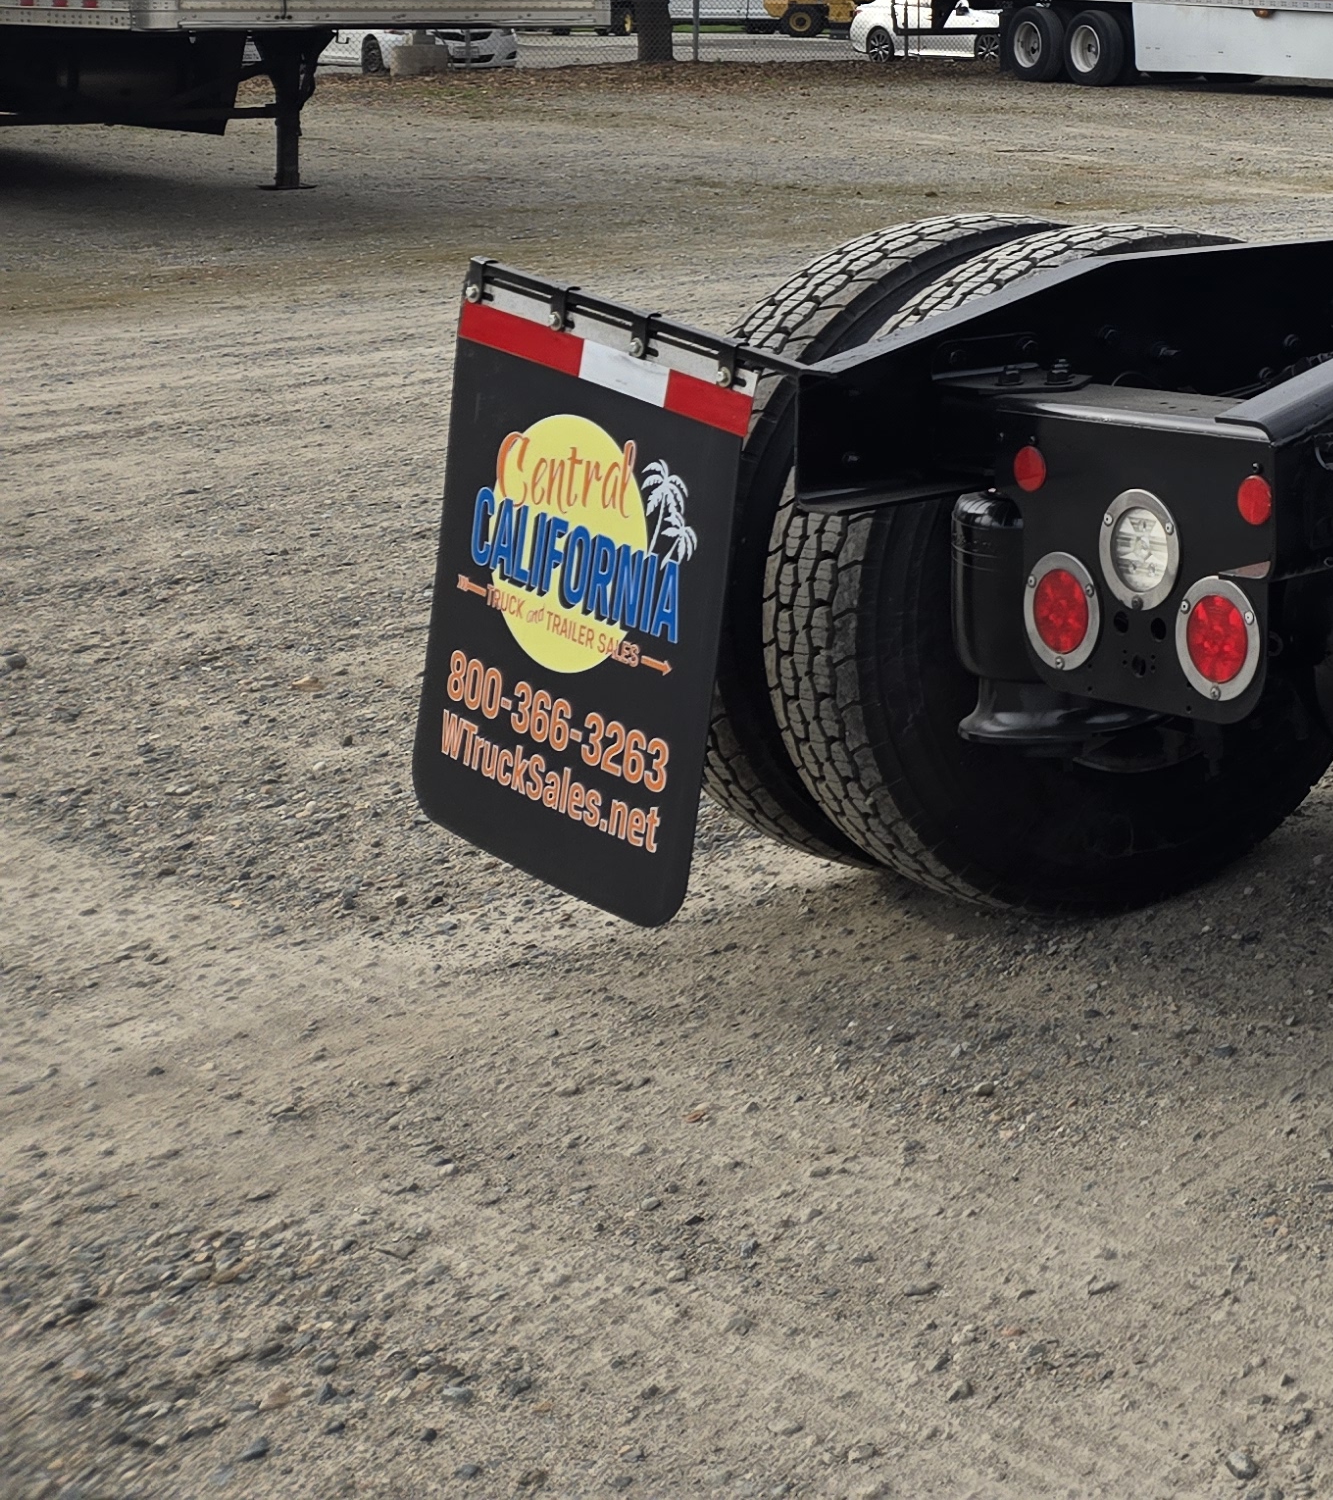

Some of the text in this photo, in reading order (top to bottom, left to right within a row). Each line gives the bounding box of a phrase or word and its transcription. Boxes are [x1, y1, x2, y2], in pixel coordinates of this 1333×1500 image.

[496, 431, 636, 518] Central
[471, 487, 679, 644] CALIFORNIA
[486, 584, 640, 667] TRUCK and TRAILER SALES
[441, 708, 660, 853] WTruckSales.net
[447, 650, 669, 793] 800-366-3263
